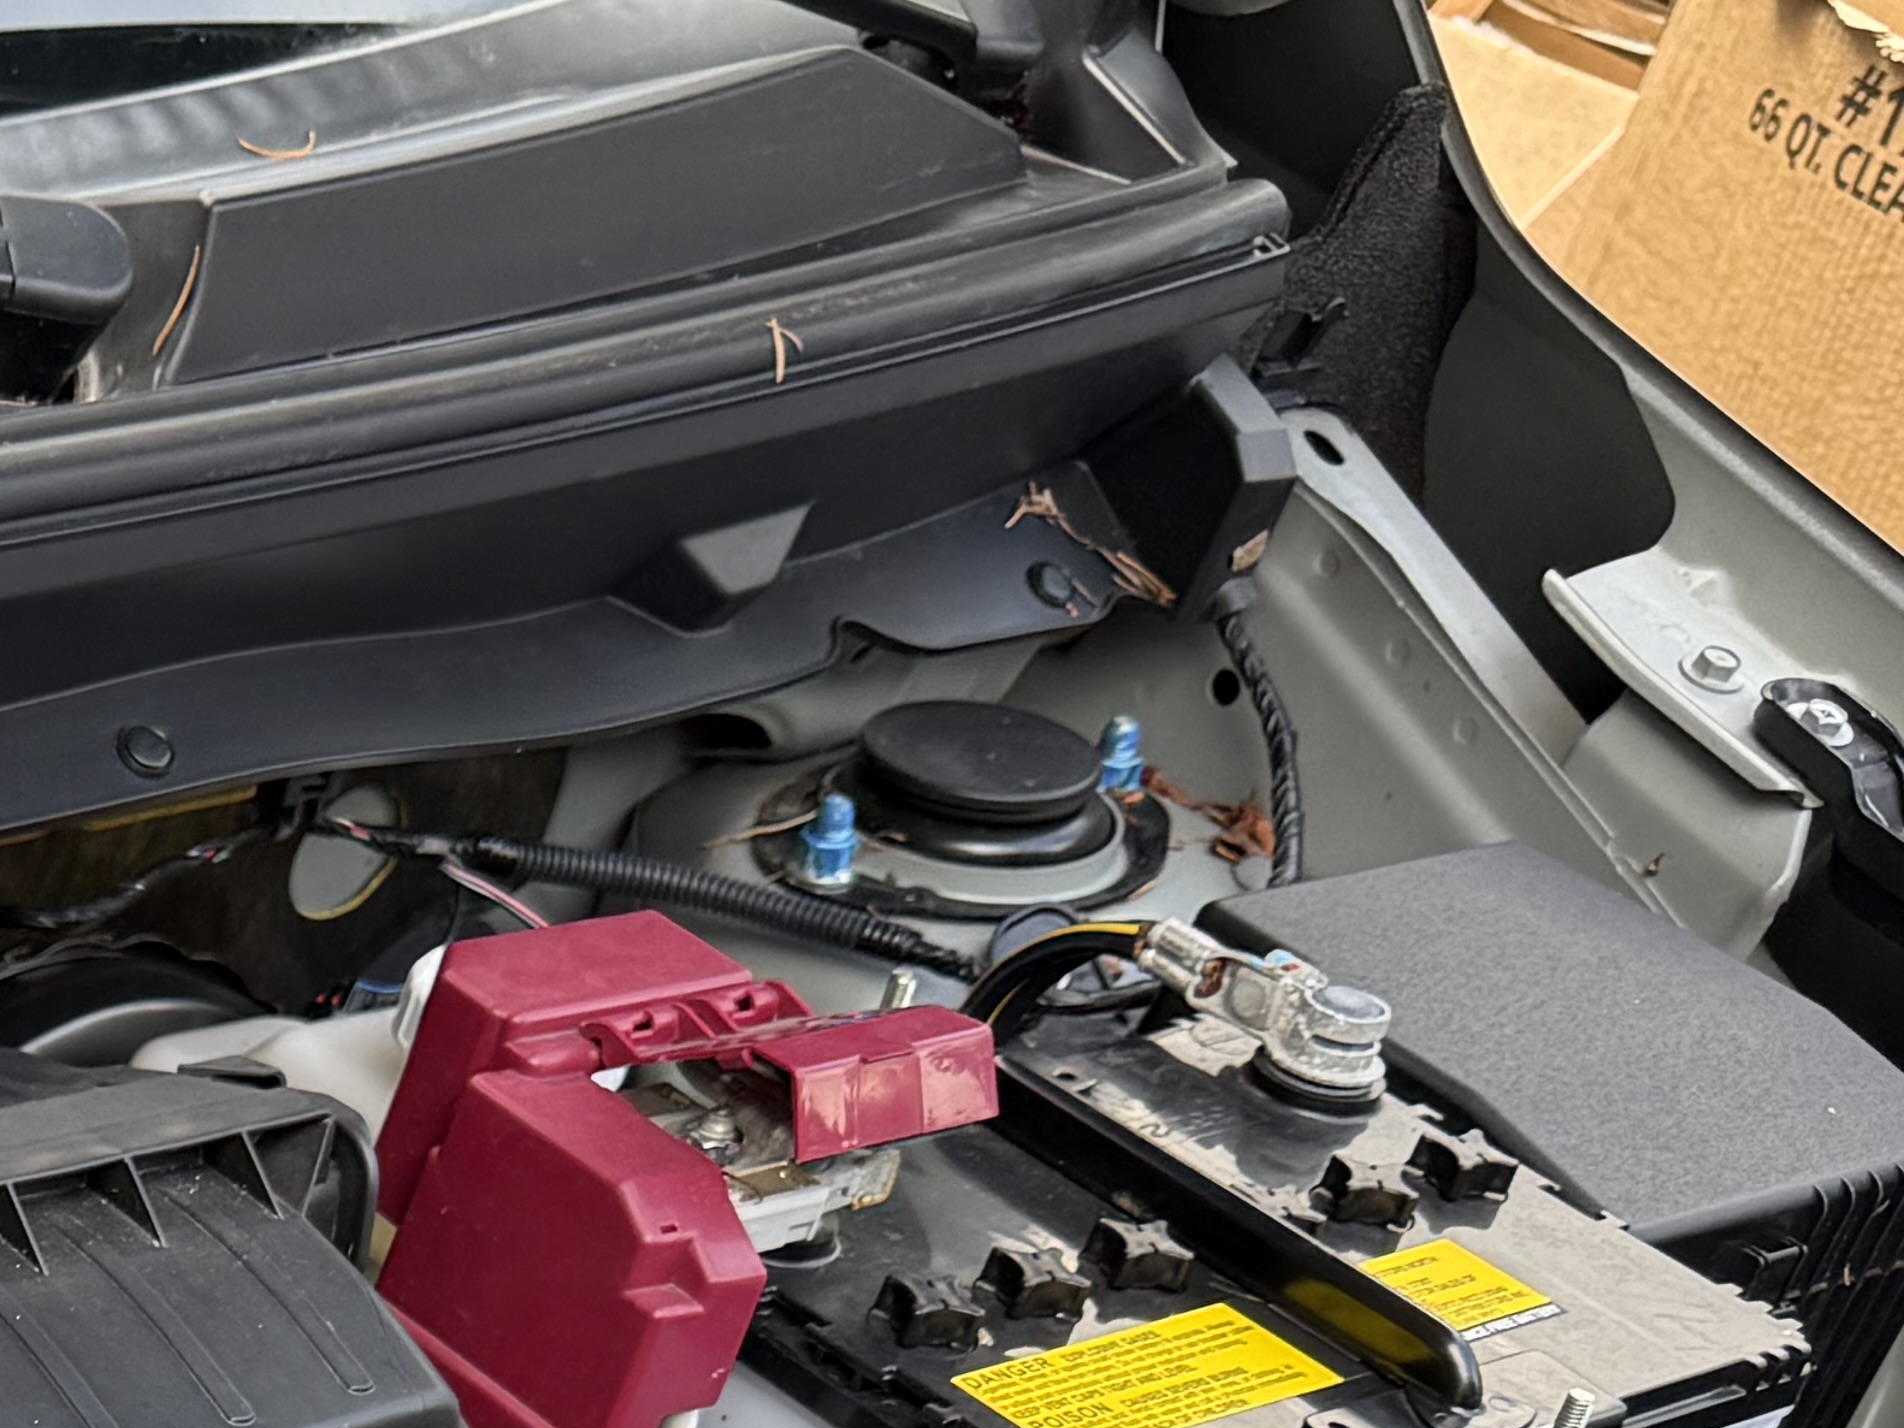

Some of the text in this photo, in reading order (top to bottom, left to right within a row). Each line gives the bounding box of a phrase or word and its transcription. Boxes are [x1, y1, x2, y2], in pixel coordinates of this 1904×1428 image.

[1749, 88, 1789, 142] 66
[1786, 112, 1831, 175] QT.
[1835, 64, 1904, 148] #1
[961, 1357, 1054, 1390] DANGER
